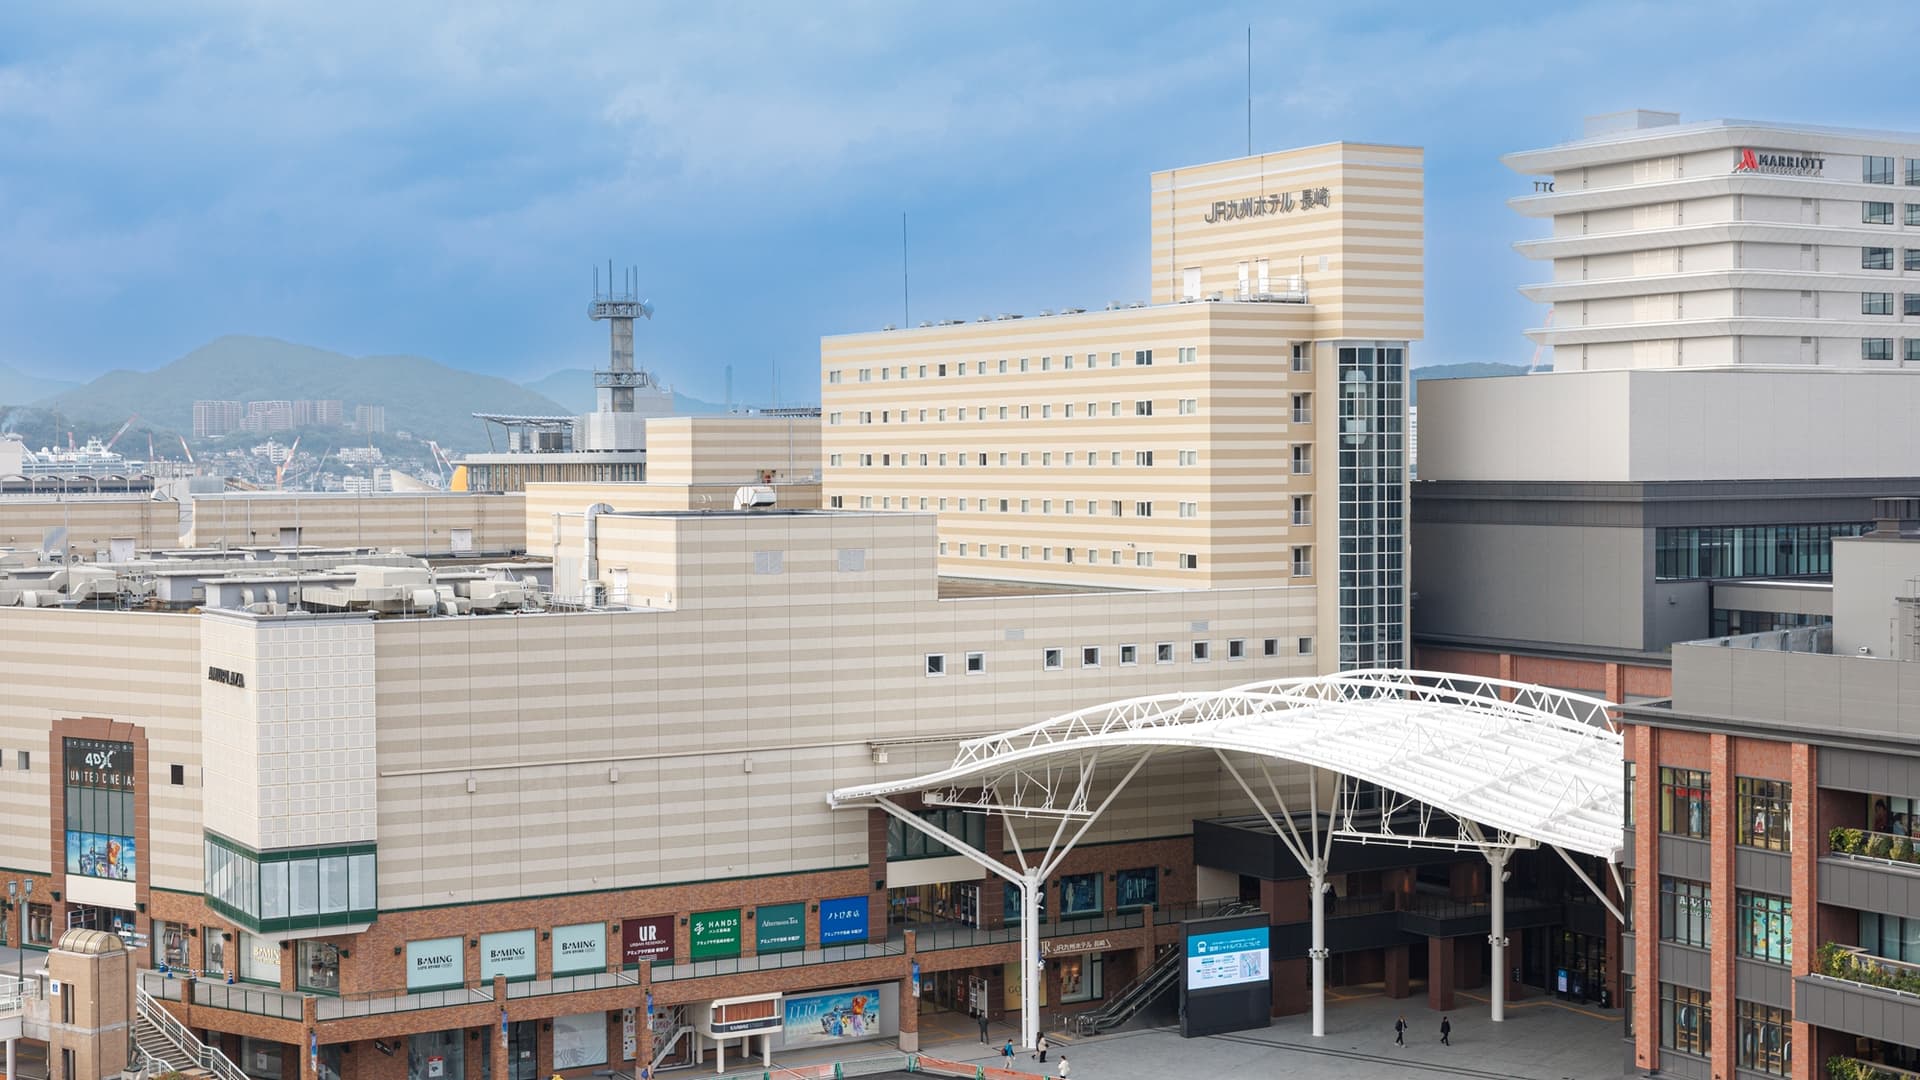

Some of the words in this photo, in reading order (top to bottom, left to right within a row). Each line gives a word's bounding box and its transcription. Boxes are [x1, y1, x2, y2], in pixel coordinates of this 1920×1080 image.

[1758, 154, 1826, 170] MARRIOTT
[1204, 192, 1295, 224] JR九州ホテル
[1300, 187, 1330, 211] 長崎
[1126, 879, 1147, 899] GAP
[708, 919, 738, 929] HANDS
[639, 925, 657, 942] UR
